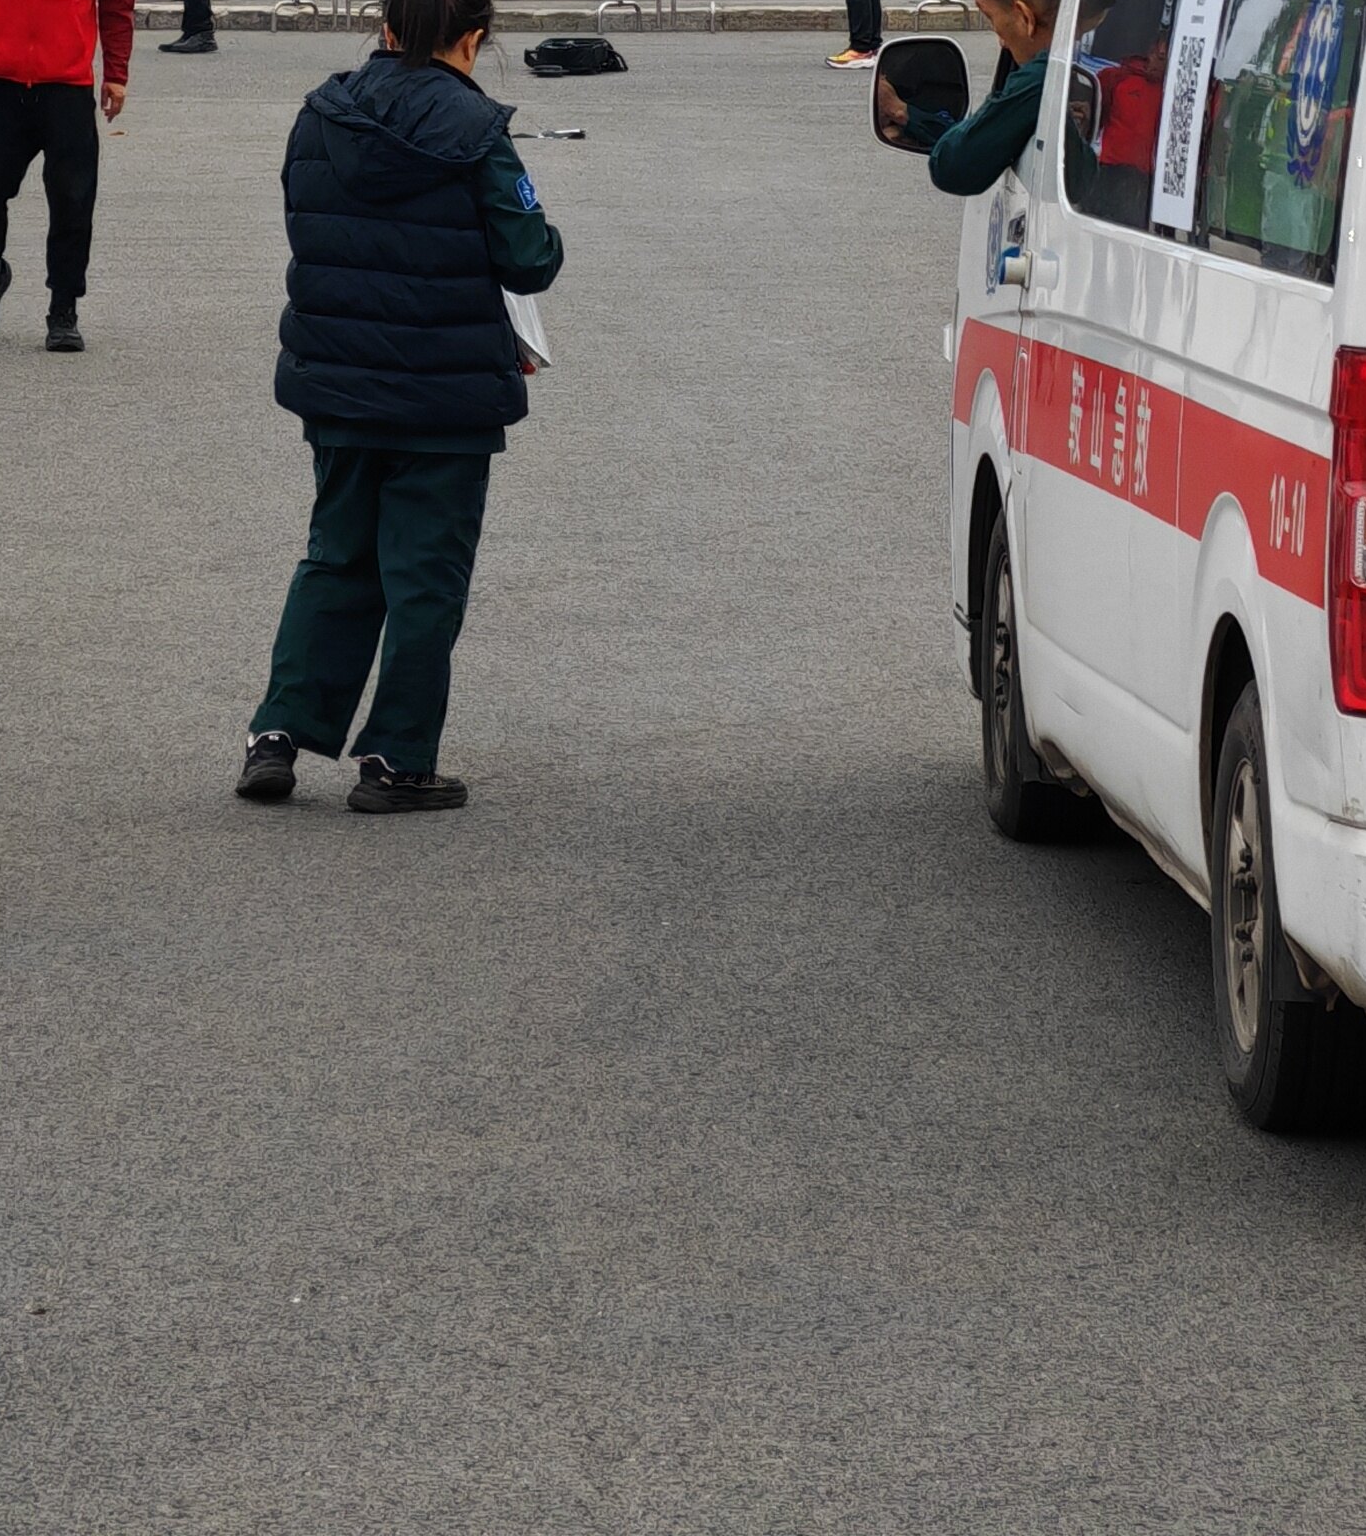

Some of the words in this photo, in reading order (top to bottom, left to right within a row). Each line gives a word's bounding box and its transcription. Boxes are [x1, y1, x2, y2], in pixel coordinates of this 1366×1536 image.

[1068, 357, 1154, 499] 鞍山急救
[1268, 471, 1308, 558] 10-10
